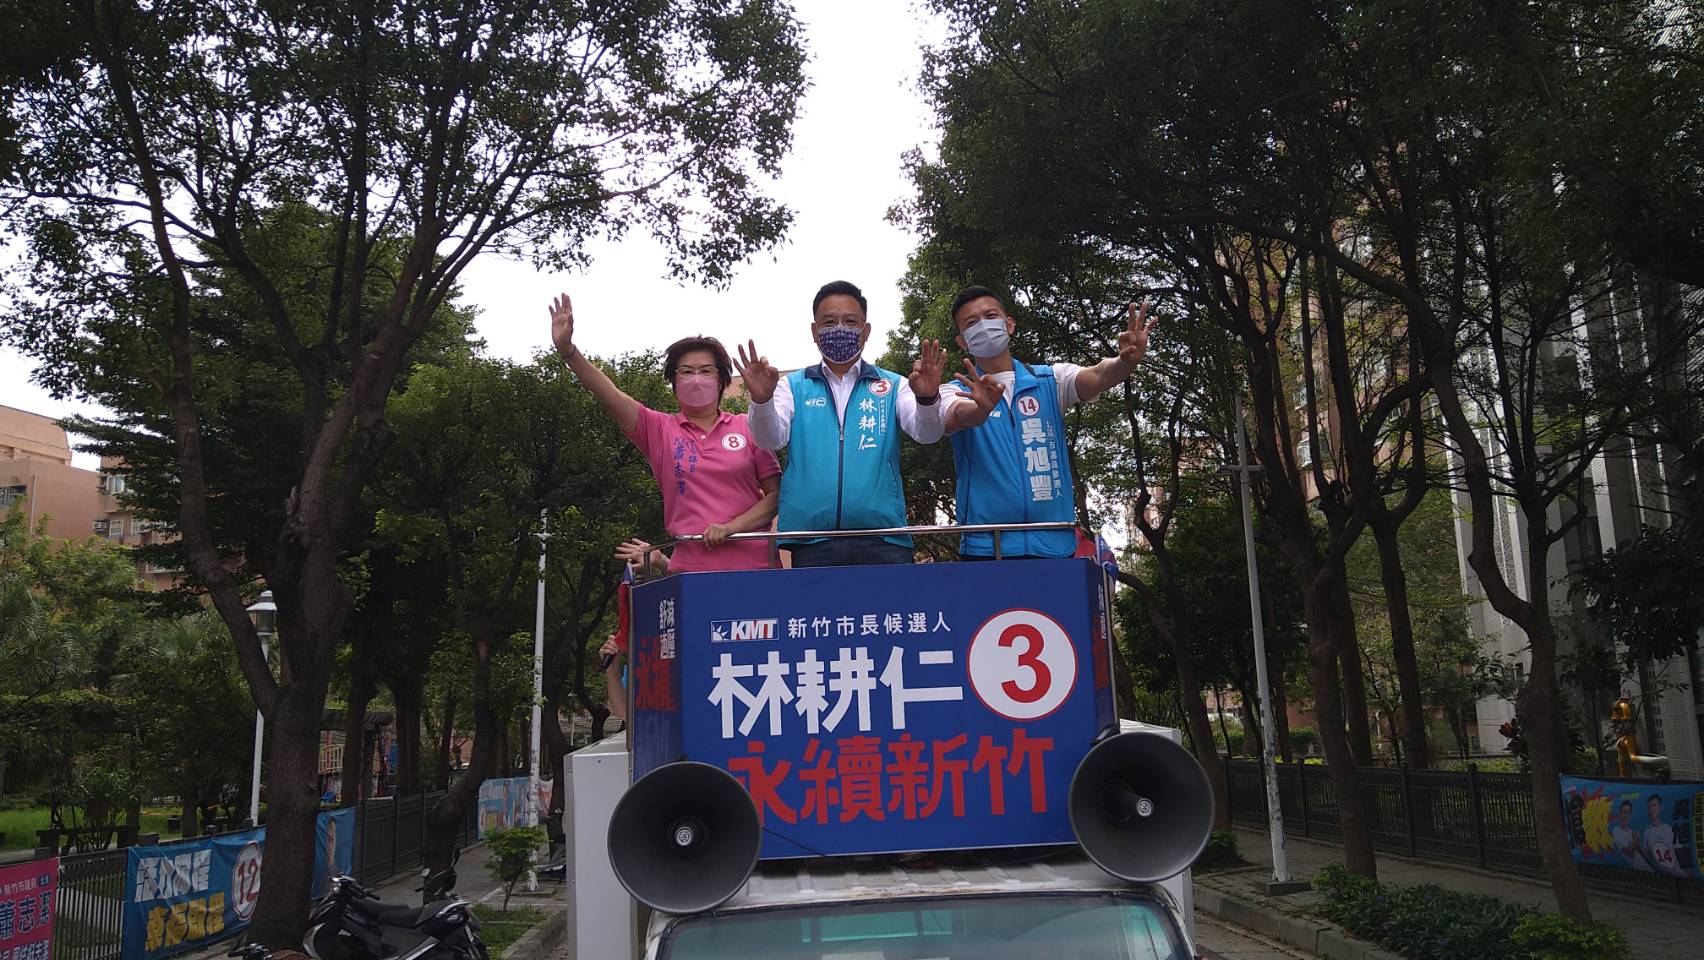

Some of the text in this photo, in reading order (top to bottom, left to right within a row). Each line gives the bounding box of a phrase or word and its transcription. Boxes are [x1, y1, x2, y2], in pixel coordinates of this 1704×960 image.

[874, 380, 888, 393] 3
[1020, 398, 1036, 413] 14
[858, 398, 878, 450] 林耕仁
[728, 436, 740, 448] 8
[730, 619, 777, 640] KMT
[787, 612, 952, 639] 新竹市長候選人
[998, 623, 1052, 704] 3
[708, 645, 964, 739] 林耕仁
[728, 728, 1055, 826] 永續新竹
[1655, 848, 1673, 863] 14
[238, 858, 260, 905] 12
